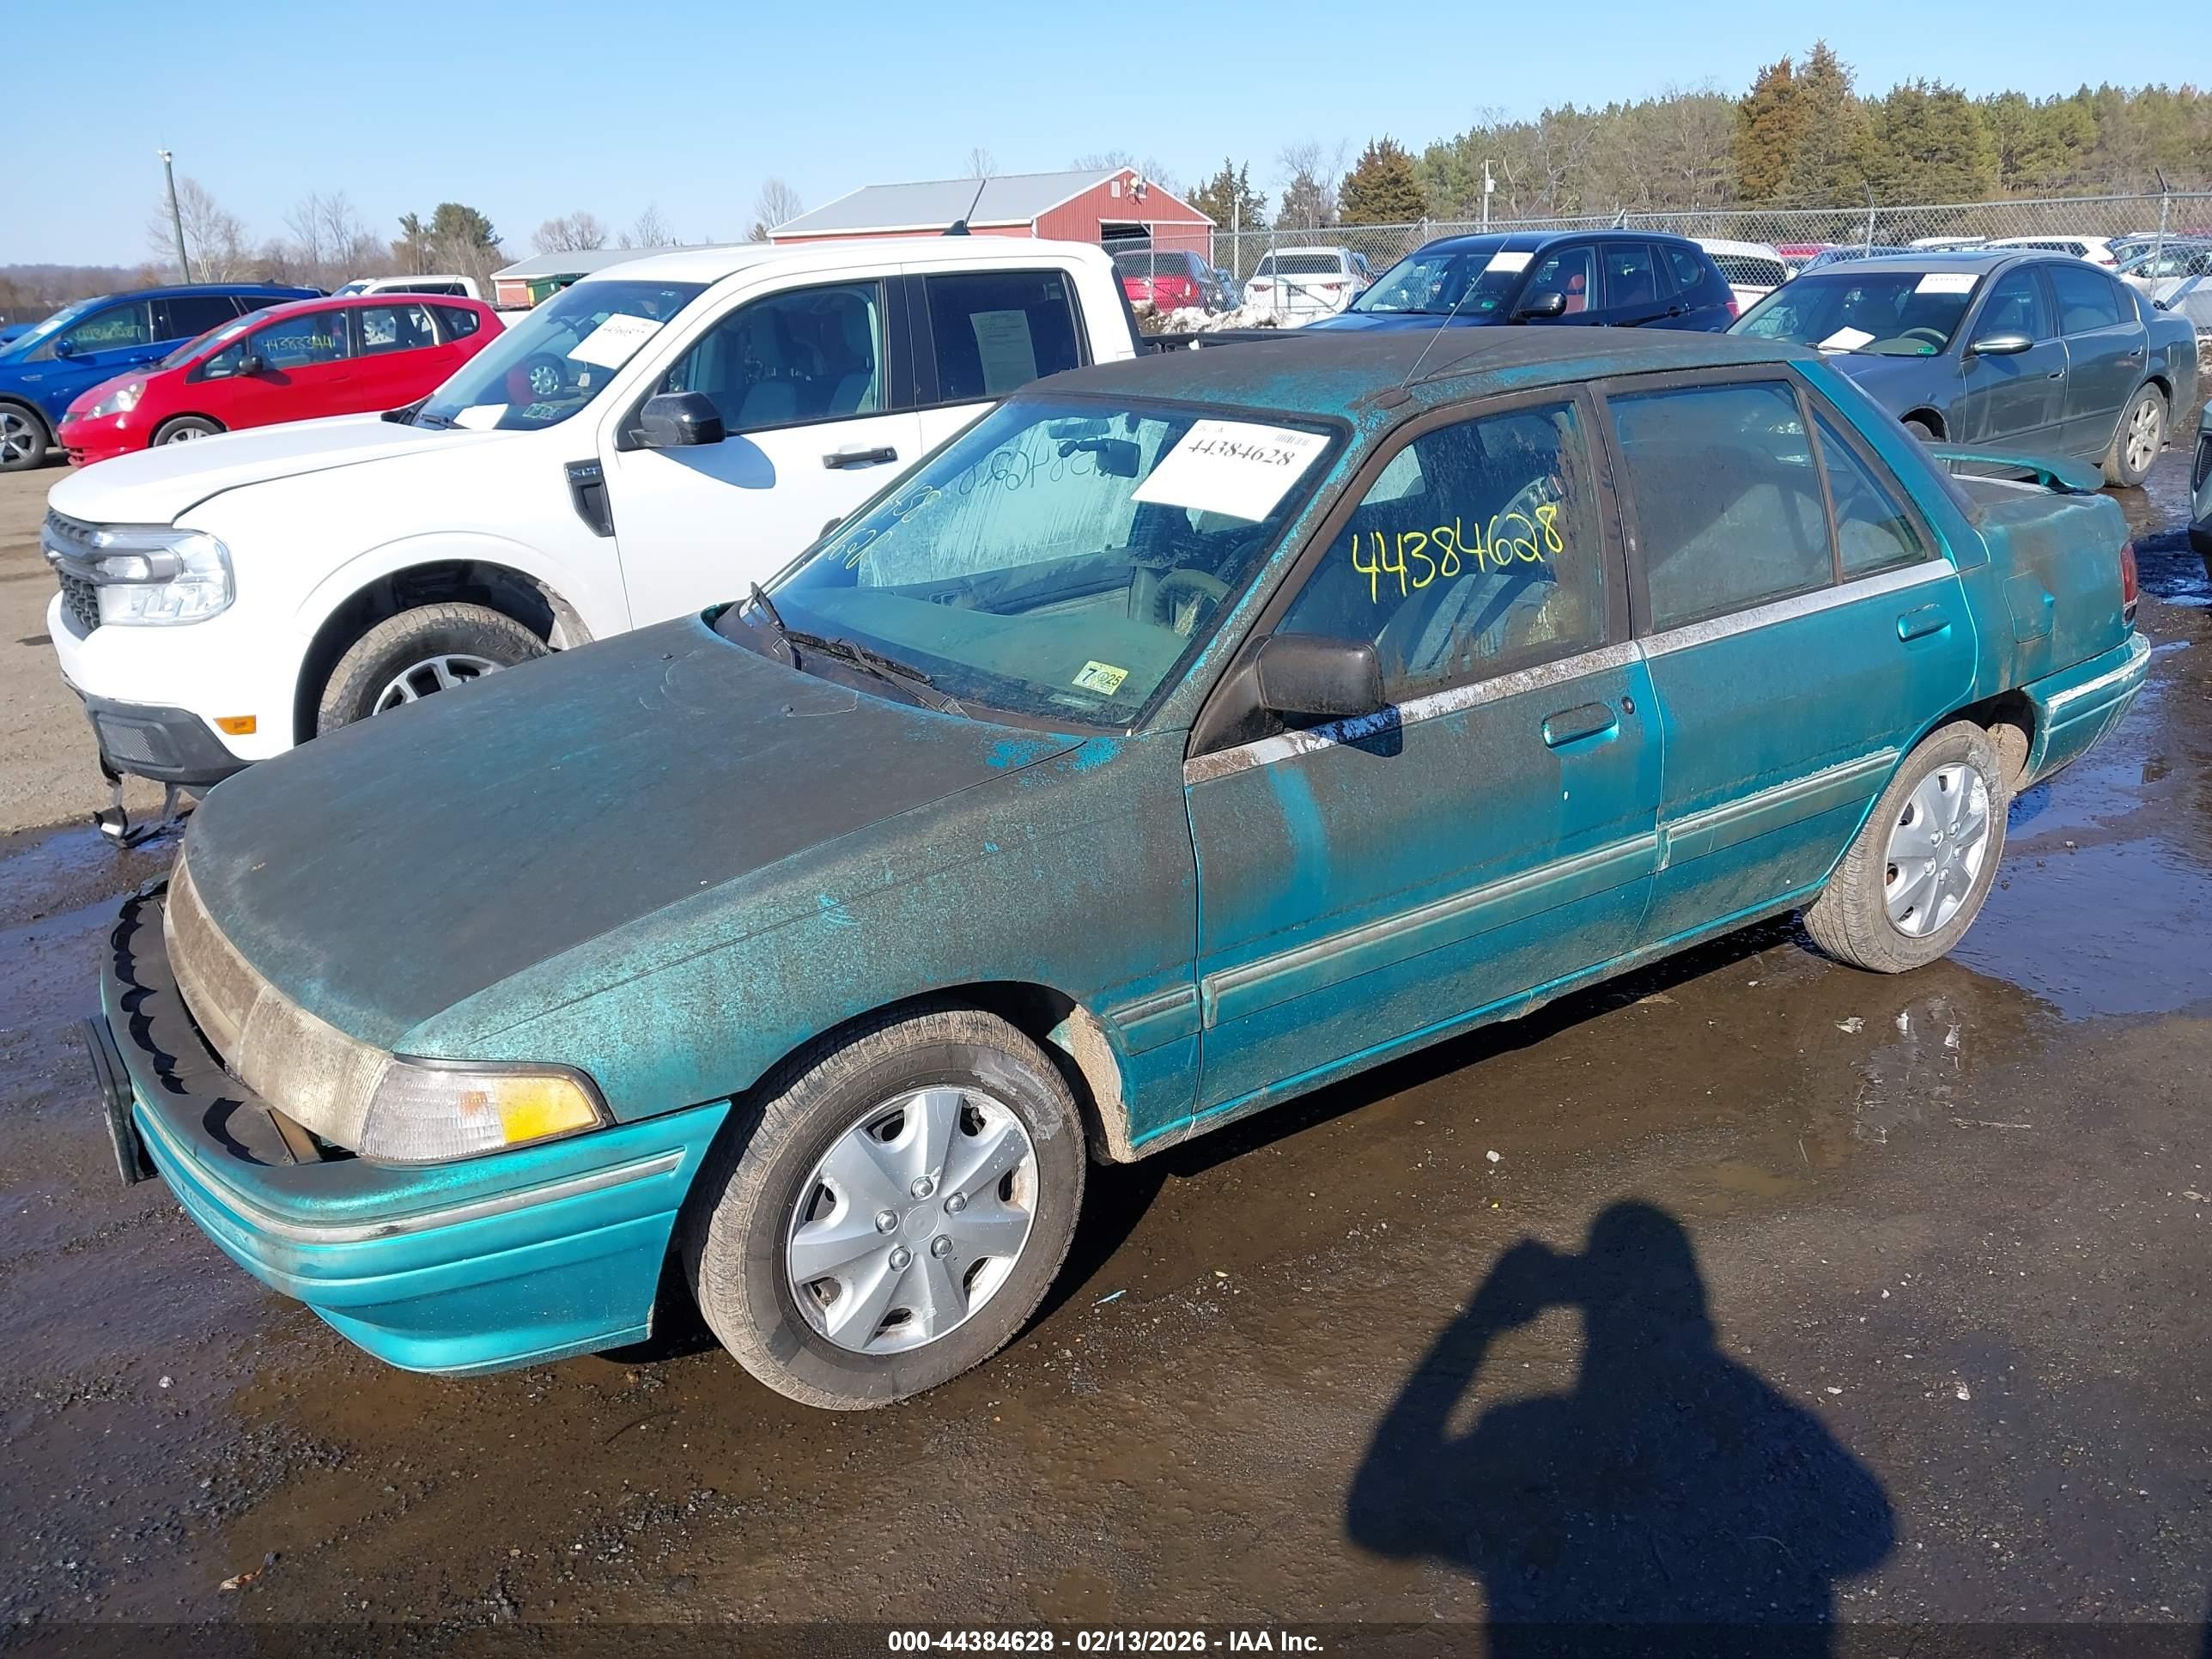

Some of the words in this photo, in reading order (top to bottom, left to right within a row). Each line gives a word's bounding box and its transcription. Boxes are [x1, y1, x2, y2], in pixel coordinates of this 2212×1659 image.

[1188, 440, 1295, 466] 44384628
[1353, 504, 1564, 605] 44384628
[1082, 667, 1098, 682] 7
[1104, 673, 1123, 686] 25
